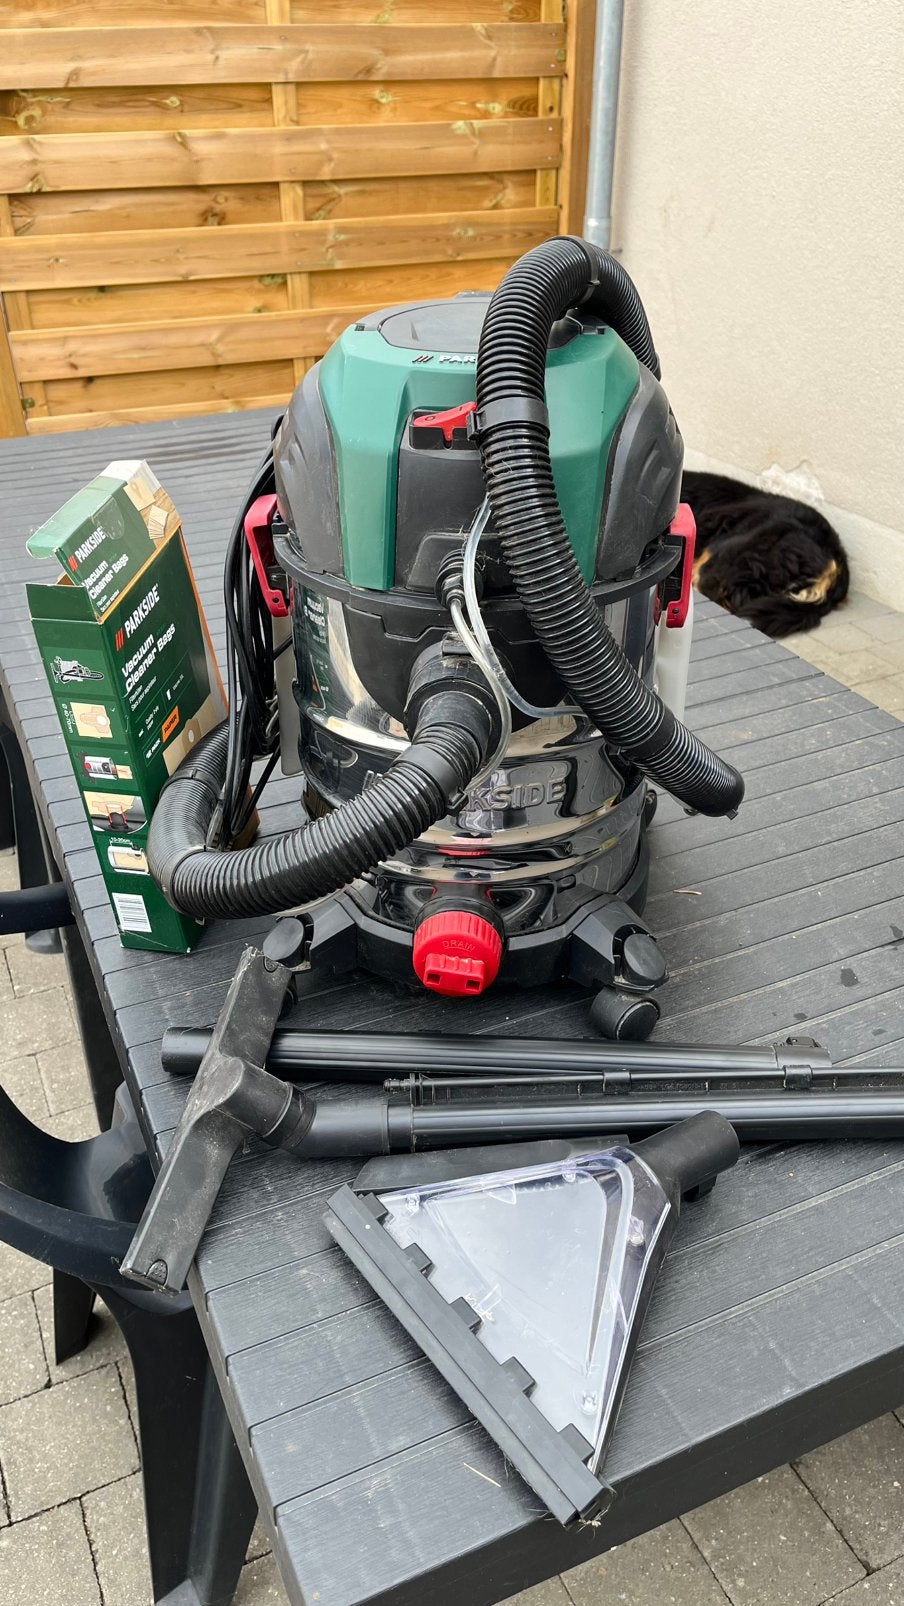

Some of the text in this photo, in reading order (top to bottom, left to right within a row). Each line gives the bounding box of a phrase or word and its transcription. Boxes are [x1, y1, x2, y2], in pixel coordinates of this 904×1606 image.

[75, 526, 106, 563] PARKSIDE
[82, 560, 109, 590] Vacuum
[89, 570, 114, 600] Cleaner
[111, 553, 129, 574] Bags
[124, 585, 160, 638] PARKSIDE
[121, 634, 155, 678] Vacuum
[126, 623, 176, 692] Cleaner Bags
[466, 778, 567, 812] KSIDE
[441, 939, 476, 952] DRAIN
